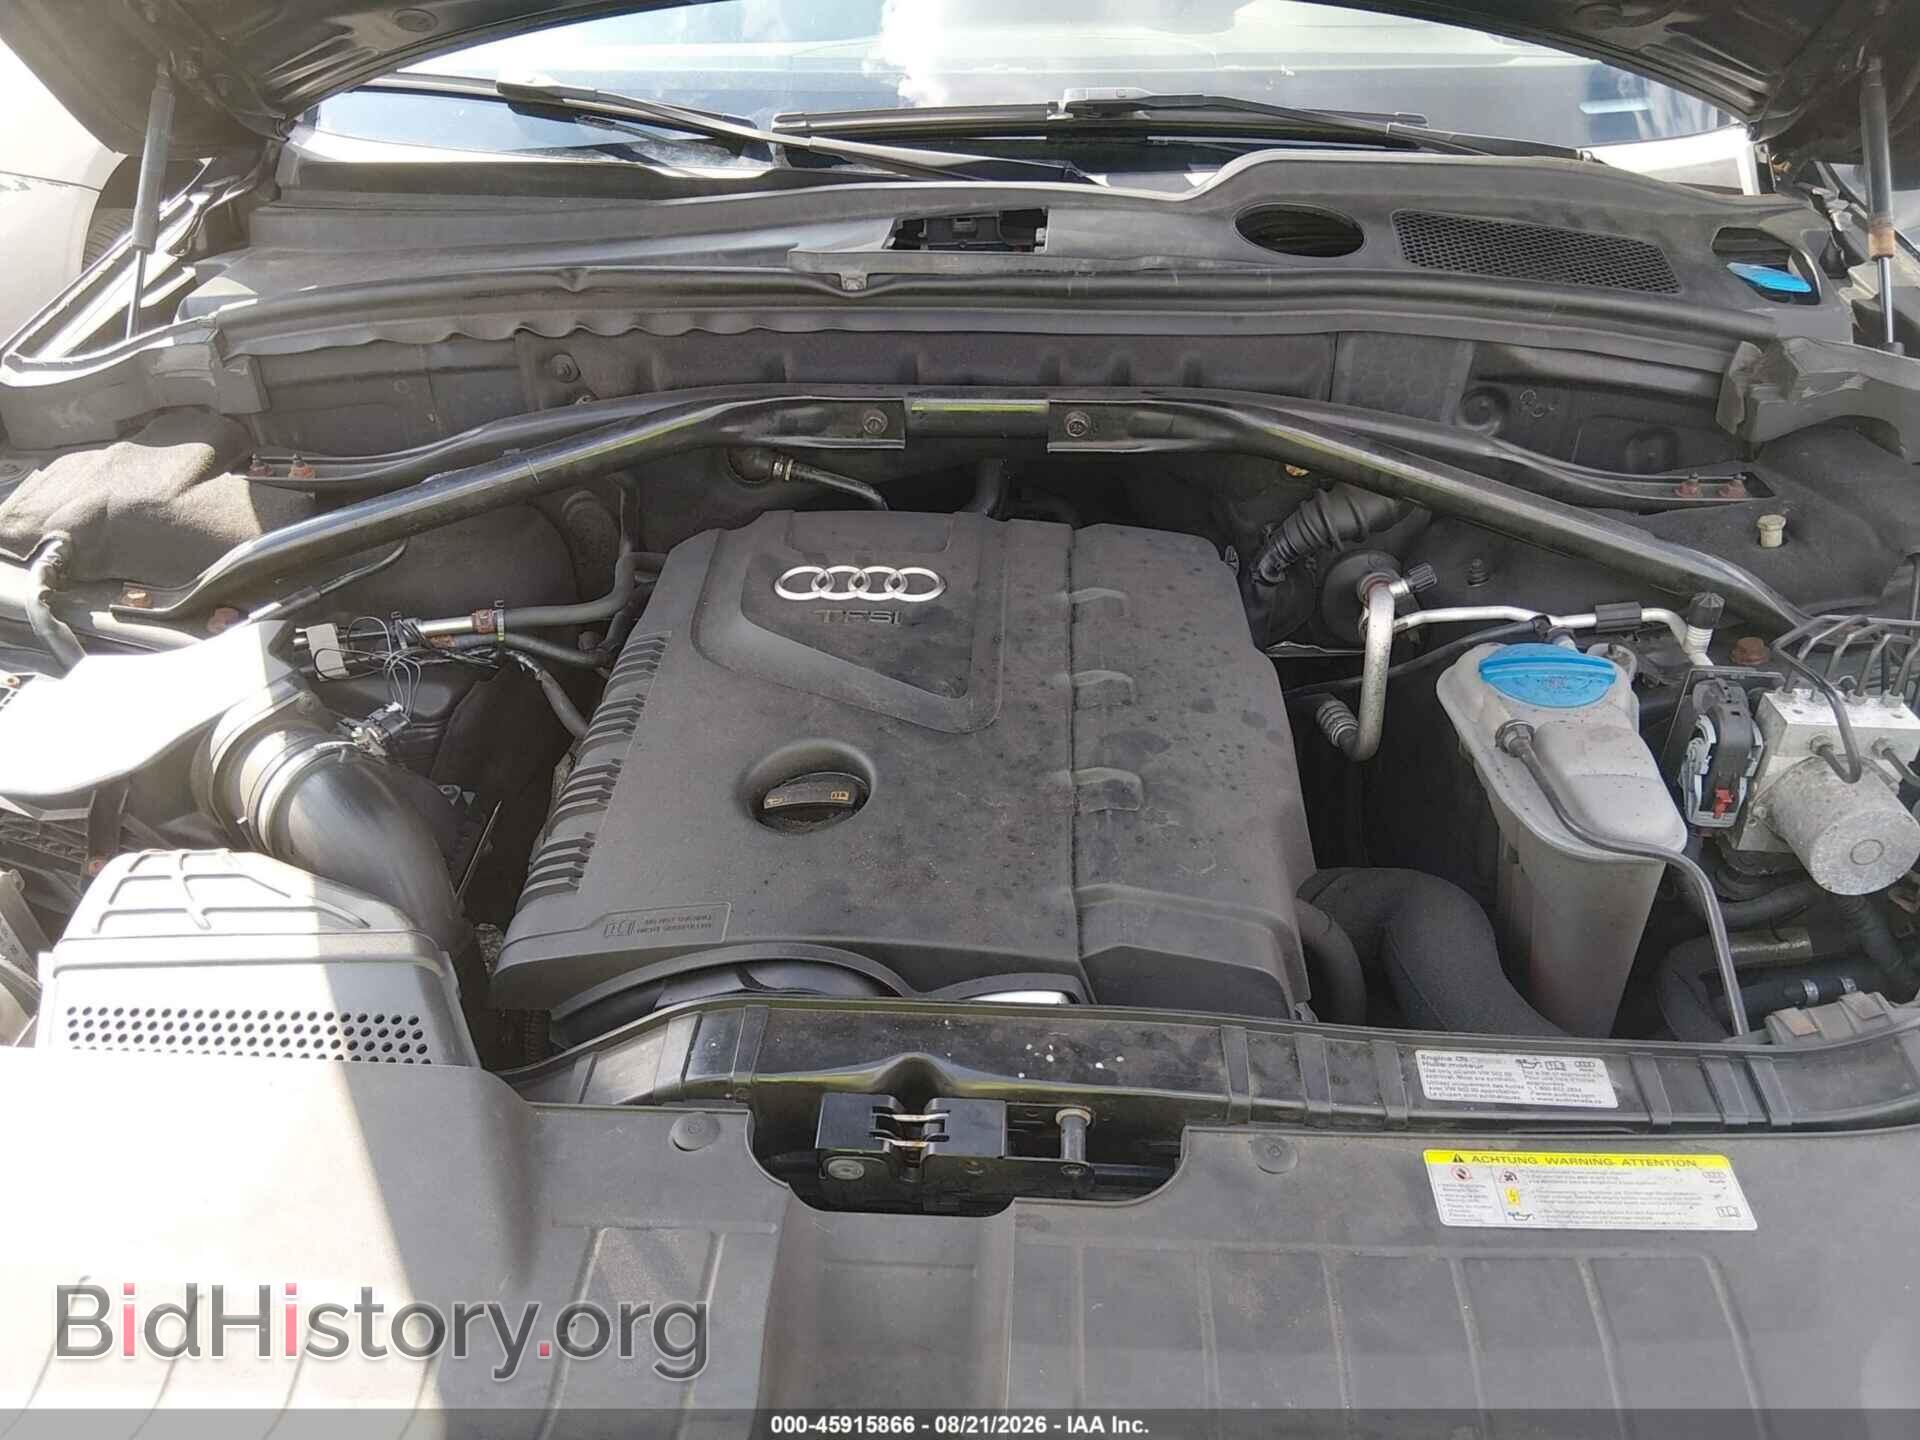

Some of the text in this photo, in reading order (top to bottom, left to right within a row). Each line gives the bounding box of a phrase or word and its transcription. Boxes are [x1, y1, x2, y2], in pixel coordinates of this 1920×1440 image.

[814, 608, 901, 625] TFSI
[1471, 1155, 1697, 1167] ACHTUNG WARNING ATTENTION
